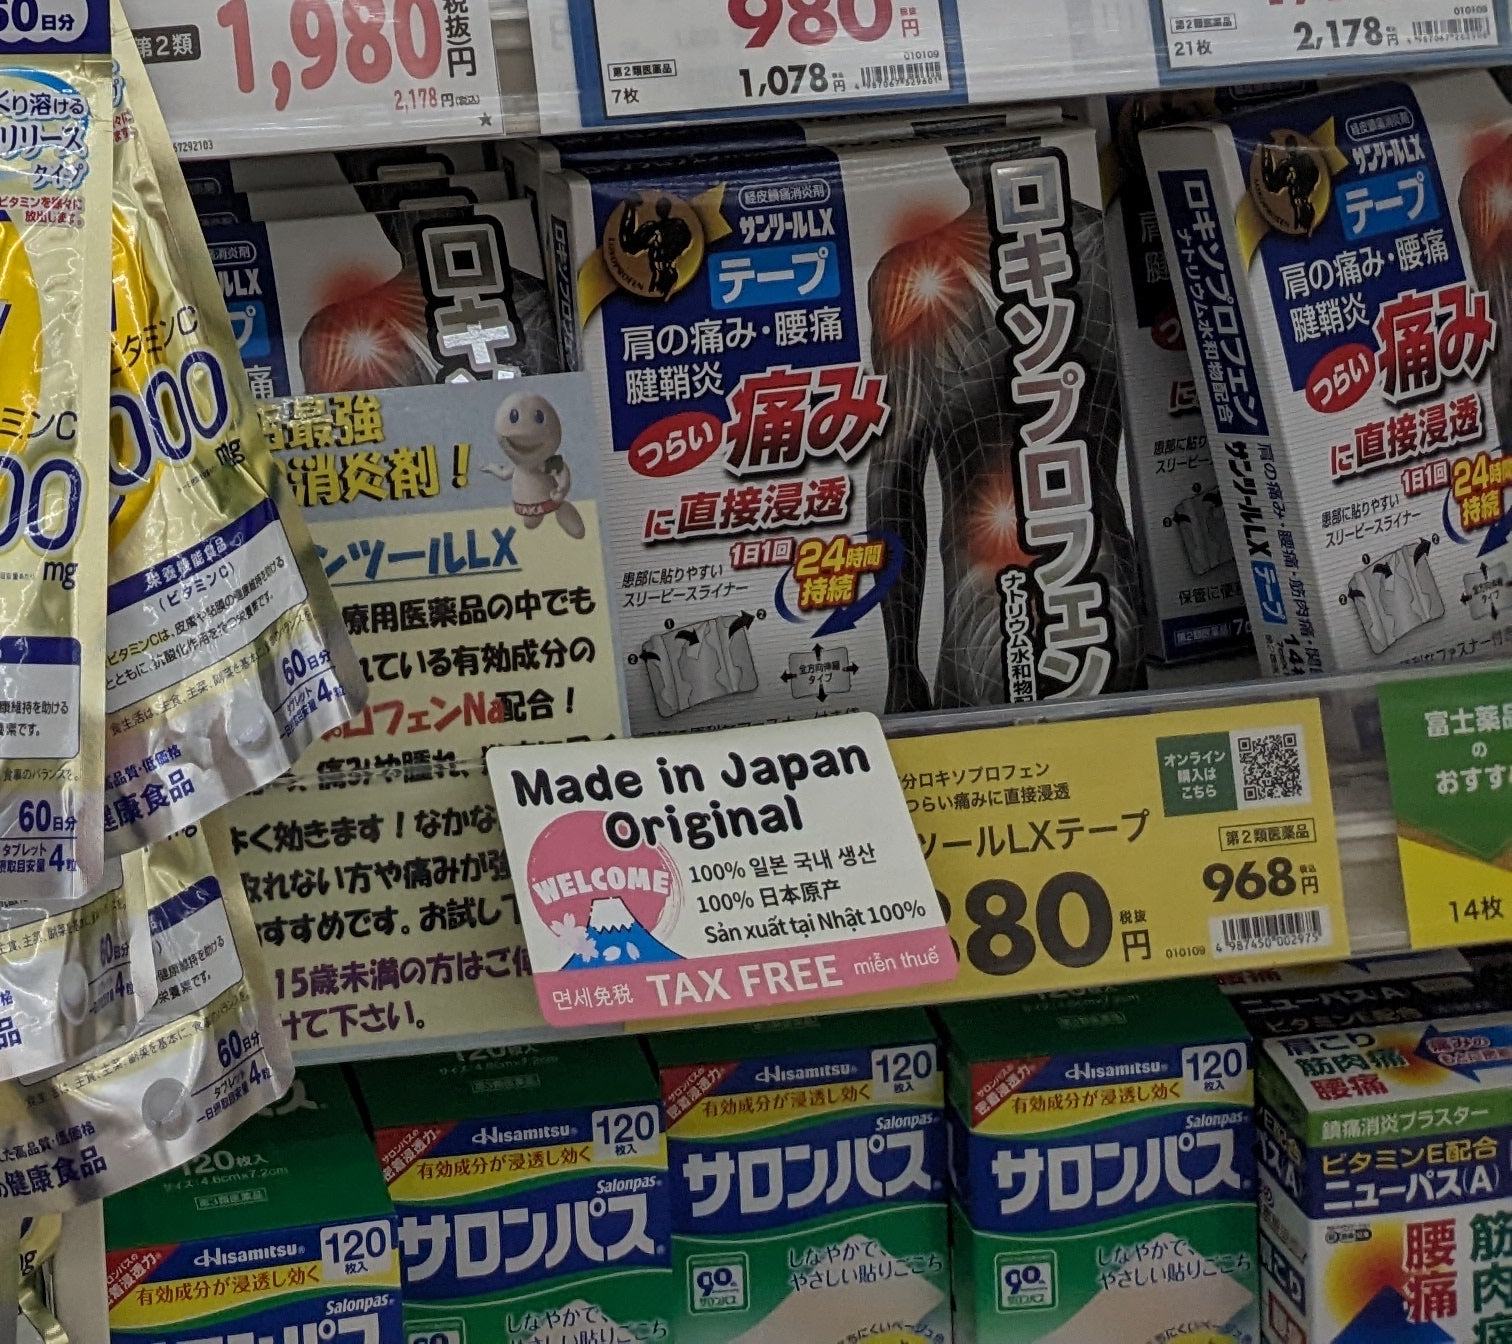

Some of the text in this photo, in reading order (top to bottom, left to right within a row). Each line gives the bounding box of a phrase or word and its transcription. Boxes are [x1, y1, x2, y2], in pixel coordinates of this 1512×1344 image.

[1174, 39, 1213, 57] 21枚
[1293, 16, 1383, 52] 2,178
[611, 88, 640, 105] 7枚
[738, 63, 829, 98] 1,078
[32, 161, 87, 190] タイプ
[716, 246, 830, 305] テープ
[1278, 229, 1450, 301] 肩の痛み・腰痛
[620, 306, 844, 363] 肩の痛み・腰痛
[624, 360, 724, 407] 腱鞘炎
[1313, 355, 1372, 409] つらい
[637, 420, 717, 473] つらい
[1331, 395, 1481, 476] に直接浸透
[643, 475, 849, 541] に直接浸透
[42, 556, 79, 590] mg
[795, 536, 885, 577] 24時間
[622, 565, 724, 589] 患部に貼りやすい
[800, 574, 856, 606] 持続
[1163, 748, 1226, 769] オンライン
[1471, 741, 1487, 757] の
[510, 743, 872, 809] Made in Japan
[1177, 766, 1218, 785] 購入は
[1181, 783, 1219, 801] こちら
[603, 794, 805, 851] Original
[1224, 823, 1311, 847] 第2類医薬品
[2, 842, 48, 858] タブレット
[688, 842, 877, 885] 100% 일본 국내 생산
[530, 865, 673, 907] WELCOME
[696, 879, 842, 915] 100% 日本原产
[1202, 856, 1298, 904] 968
[704, 900, 927, 946] Sản xuất tại Nhật 100%
[1449, 896, 1504, 924] 14枚
[646, 967, 731, 1008] TAX
[738, 954, 845, 999] FREE
[755, 1063, 851, 1083] Hisamitsu
[875, 1050, 933, 1083] 120
[471, 1124, 571, 1145] Hisamitsu
[596, 1111, 655, 1144] 120
[875, 1112, 934, 1132] Salonpas
[1321, 1106, 1490, 1141] 鎮痛消炎プラスター
[615, 1143, 638, 1156] 枚入
[1322, 1135, 1499, 1176] ビタミンE配合
[596, 1175, 657, 1195] Salonpas
[682, 1129, 932, 1218] サロンパス
[991, 1128, 1241, 1215] サロンパス
[1323, 1164, 1501, 1211] ニューパス(A)
[324, 1226, 387, 1264] 120
[398, 1192, 655, 1283] サロンパス
[194, 1243, 298, 1268] Hisamitsu
[345, 1261, 368, 1275] 枚入
[137, 1265, 321, 1307] 有効成分が浸透し効く
[325, 1294, 389, 1316] Salonpas
